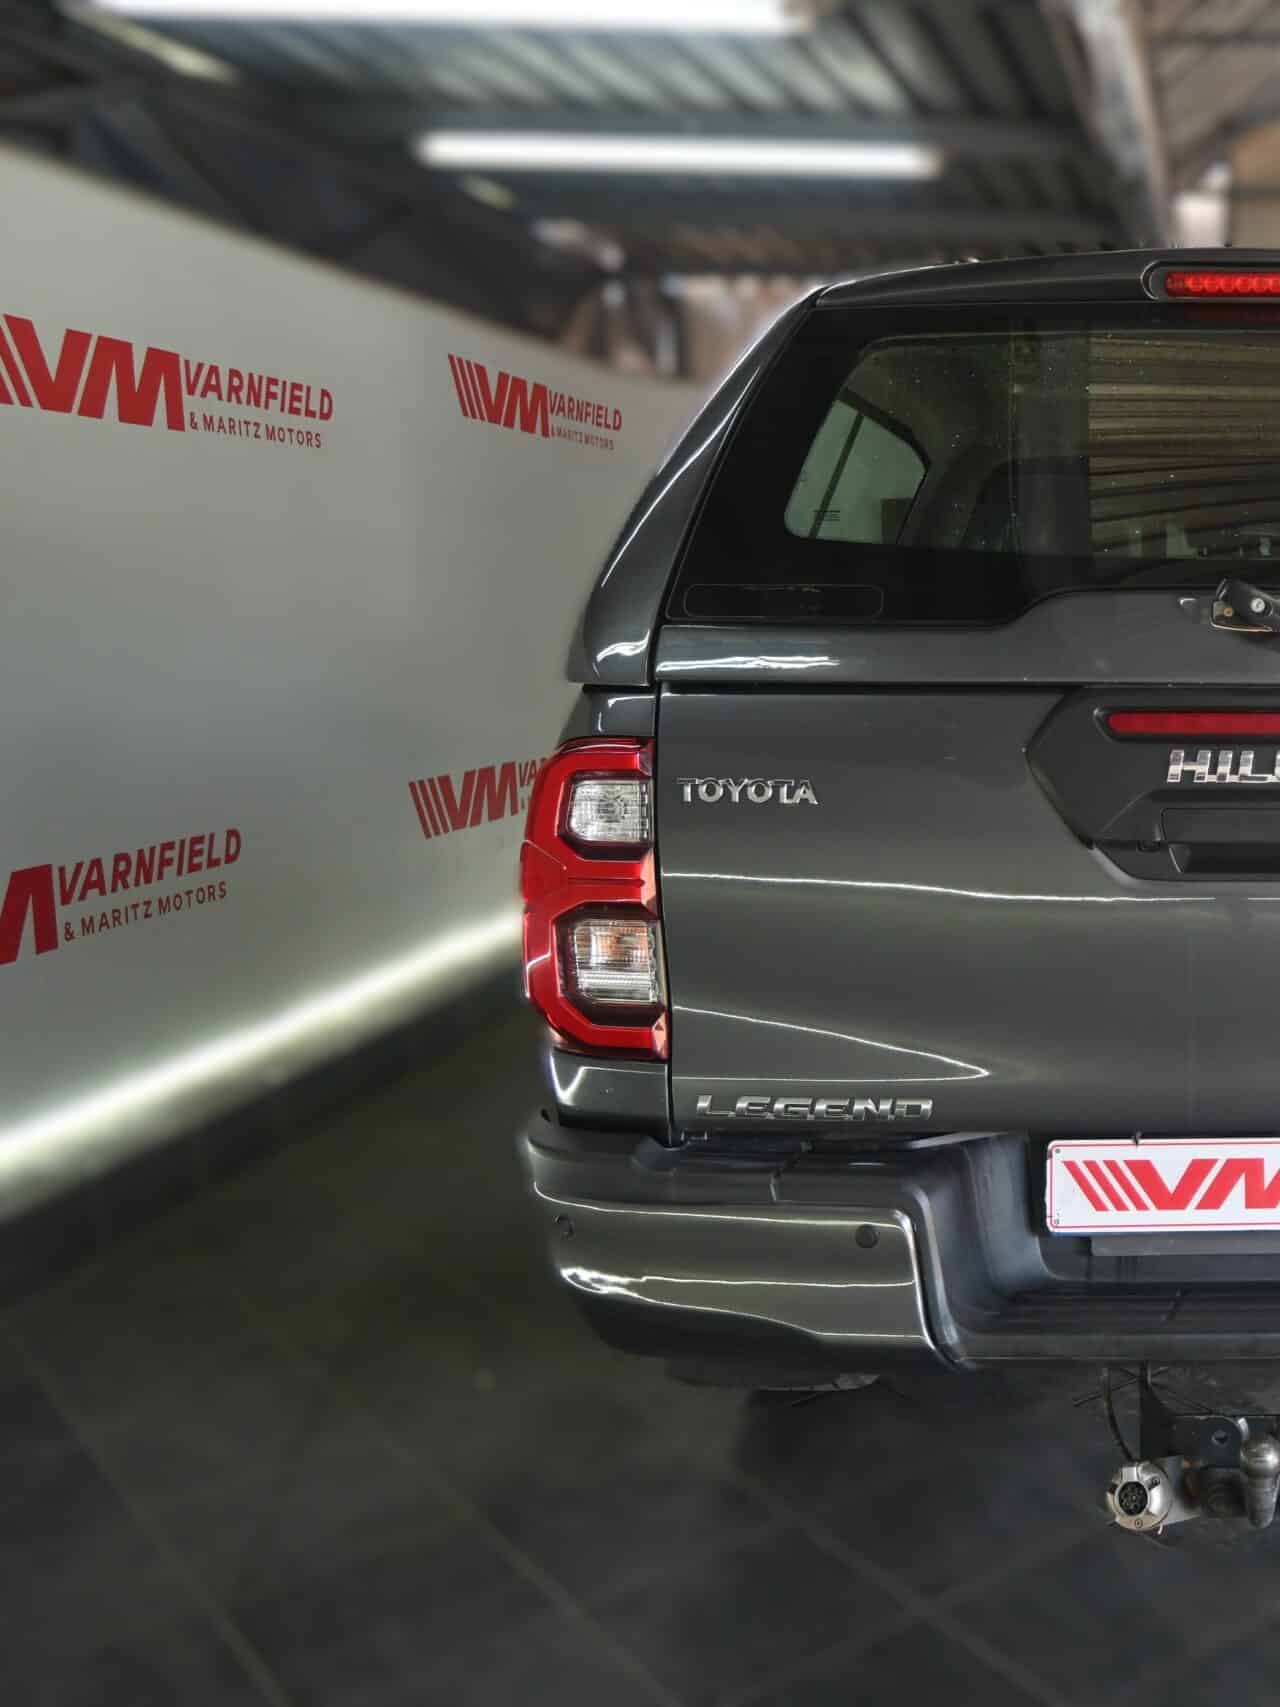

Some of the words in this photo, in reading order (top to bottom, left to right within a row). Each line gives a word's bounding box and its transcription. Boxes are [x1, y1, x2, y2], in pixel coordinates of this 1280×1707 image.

[184, 359, 334, 422] VARNFIELD
[549, 389, 623, 431] VARNFIELD
[189, 411, 198, 431] &
[202, 413, 262, 439] MARITZ
[265, 423, 322, 449] MOTORS
[677, 777, 818, 804] TOYOTA
[58, 828, 242, 907] VARNFIELD
[63, 921, 75, 942] &
[81, 900, 153, 937] MARITZ
[158, 881, 227, 917] MOTORS
[697, 1095, 933, 1121] LEGEND
